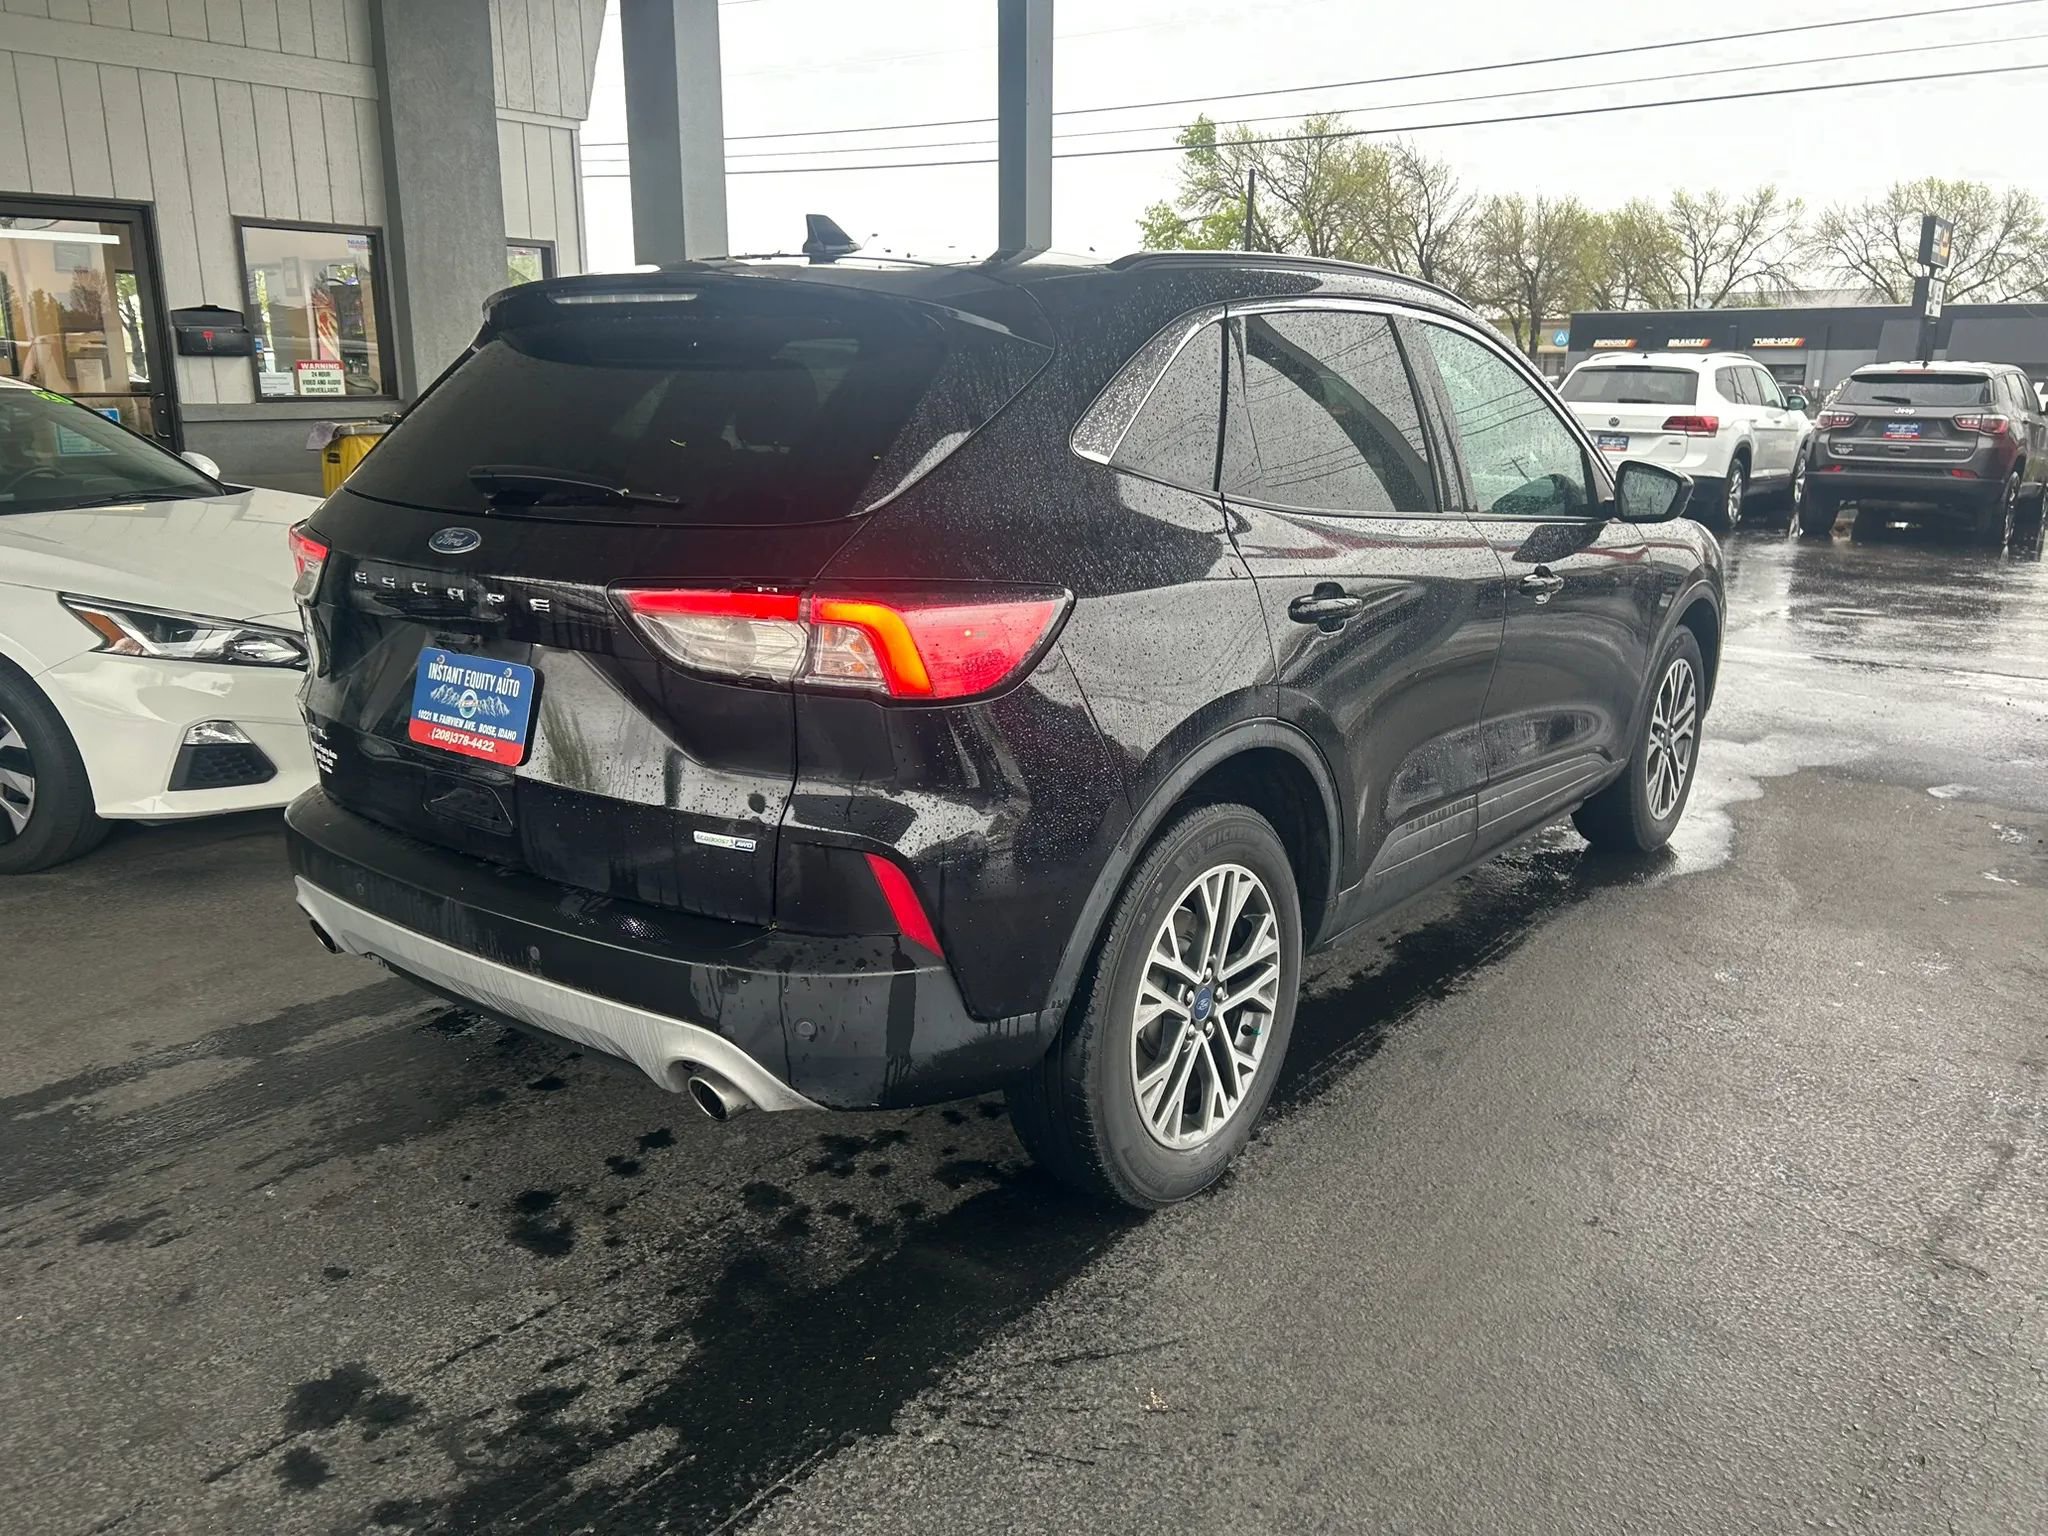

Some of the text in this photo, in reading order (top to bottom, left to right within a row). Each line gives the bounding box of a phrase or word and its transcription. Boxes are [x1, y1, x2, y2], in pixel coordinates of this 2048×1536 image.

[1667, 338, 1703, 347] BRAKES
[300, 362, 340, 370] WARNING
[1894, 407, 1916, 415] Jeep
[354, 570, 551, 613] ESCAPE
[428, 662, 521, 698] INSTANT EQUITY AUTO
[417, 709, 432, 721] 10221
[438, 714, 466, 729] FAIRVIEW
[464, 719, 477, 732] AVE.
[478, 723, 497, 738] BOISE,
[497, 727, 517, 741] IDAHO
[431, 727, 495, 753] (208)378-4422
[735, 841, 753, 849] AWD
